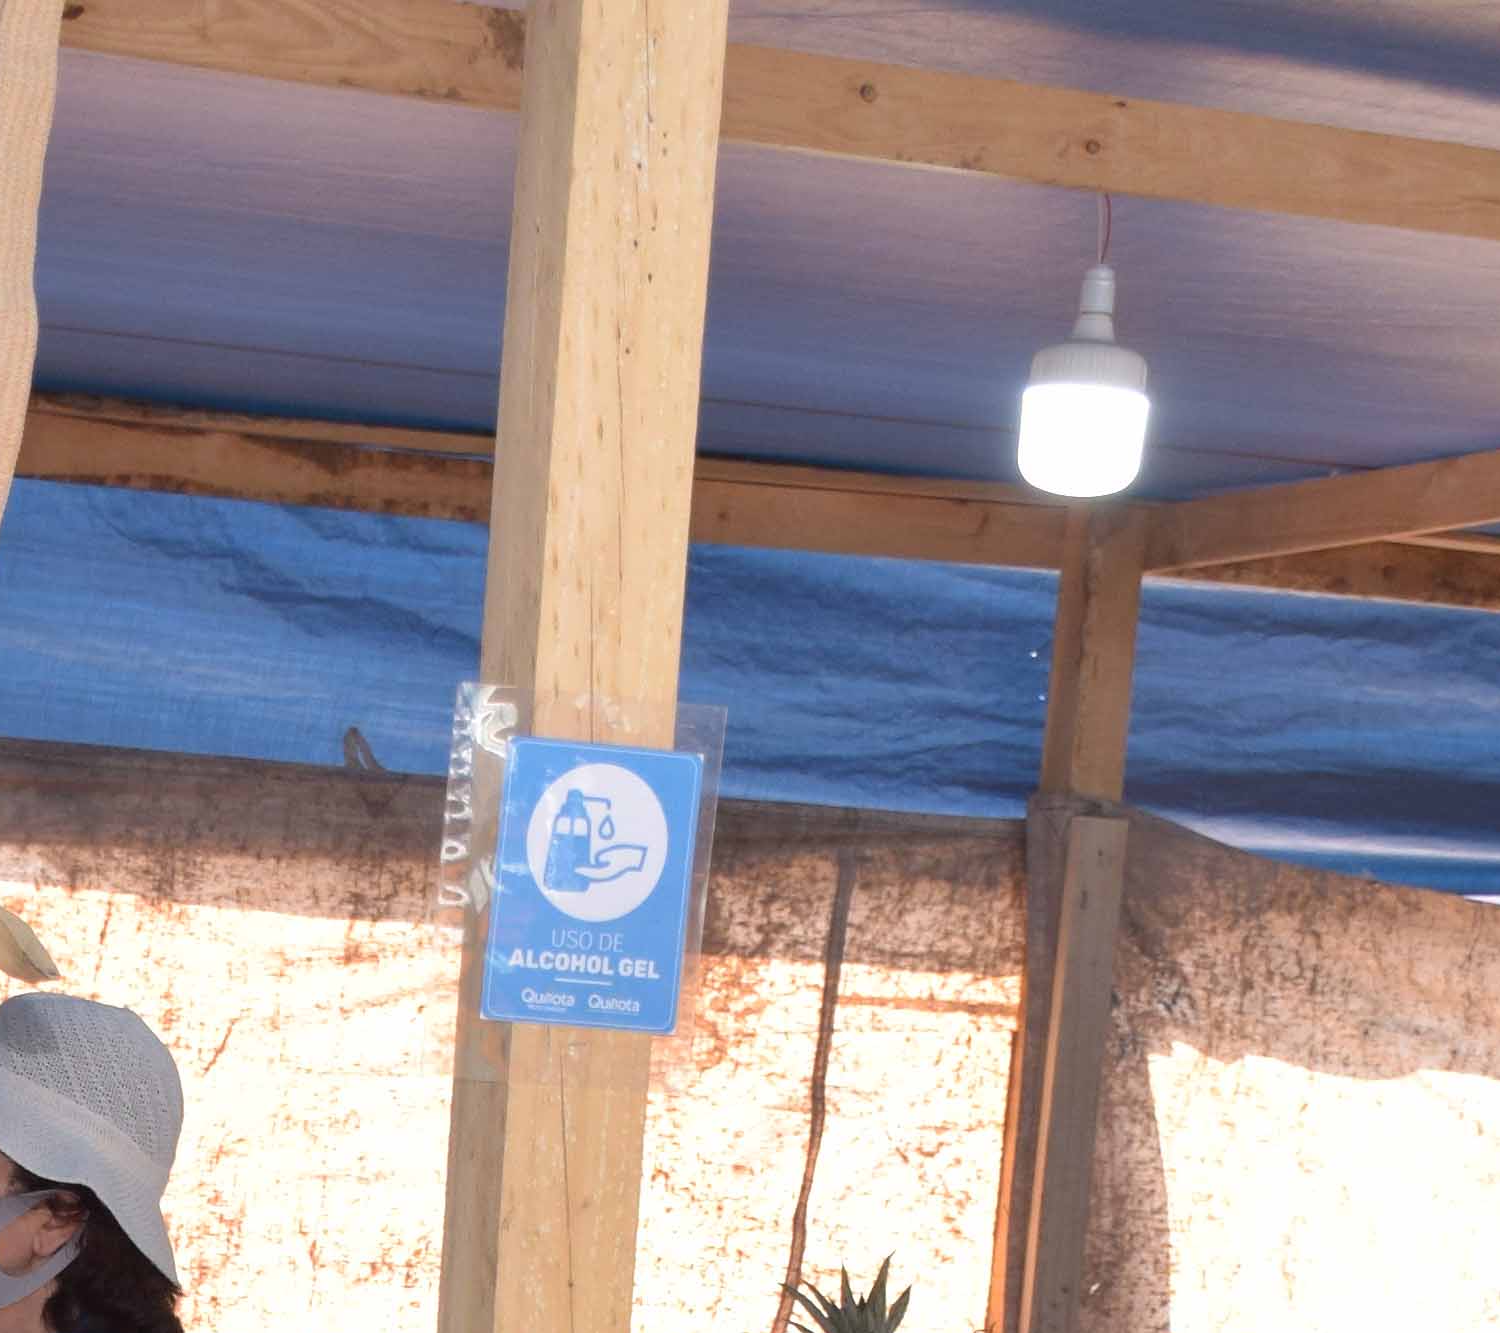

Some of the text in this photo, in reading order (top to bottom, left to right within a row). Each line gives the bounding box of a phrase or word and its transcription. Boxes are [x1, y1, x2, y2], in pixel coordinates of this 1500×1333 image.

[551, 928, 624, 953] USO DE
[508, 948, 660, 979] ALCOHOL GEL
